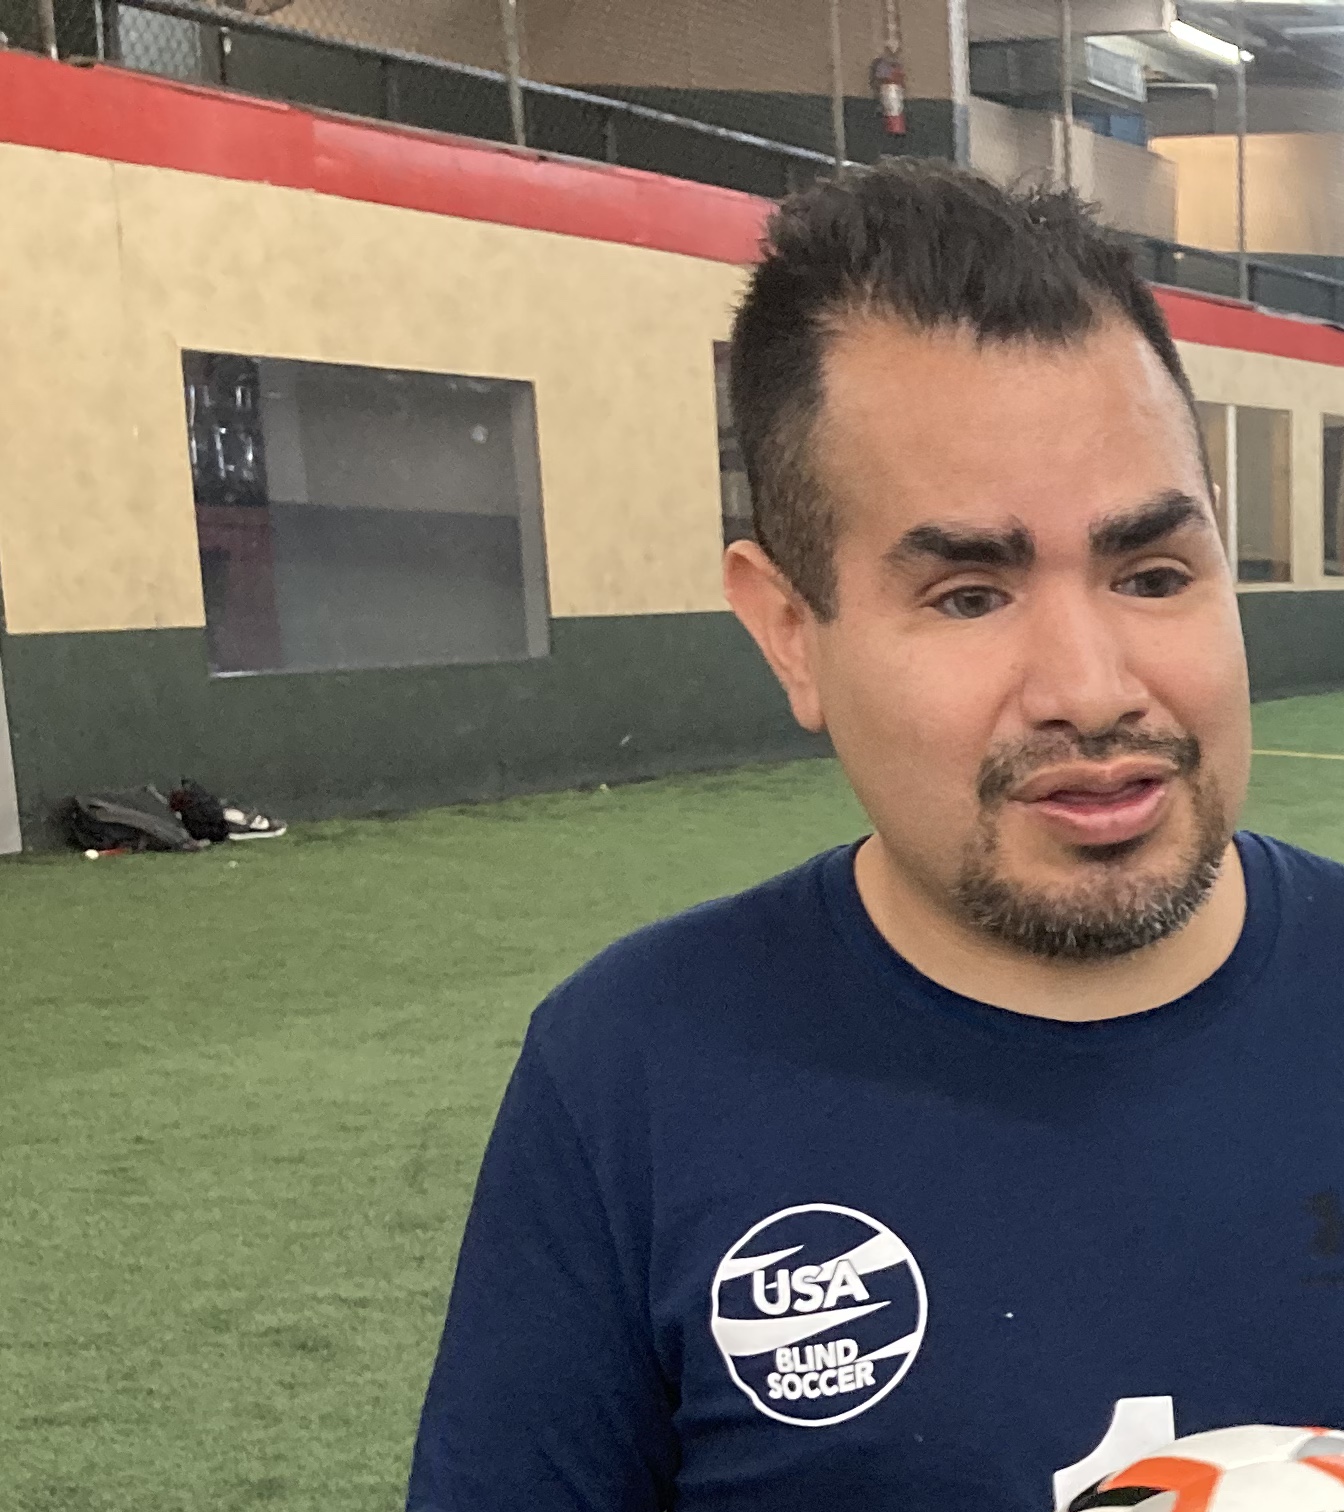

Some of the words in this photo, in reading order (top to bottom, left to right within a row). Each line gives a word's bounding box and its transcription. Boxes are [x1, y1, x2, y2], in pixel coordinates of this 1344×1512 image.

[752, 1258, 870, 1315] USA
[775, 1338, 858, 1374] BLIND
[767, 1360, 876, 1400] SOCCER
